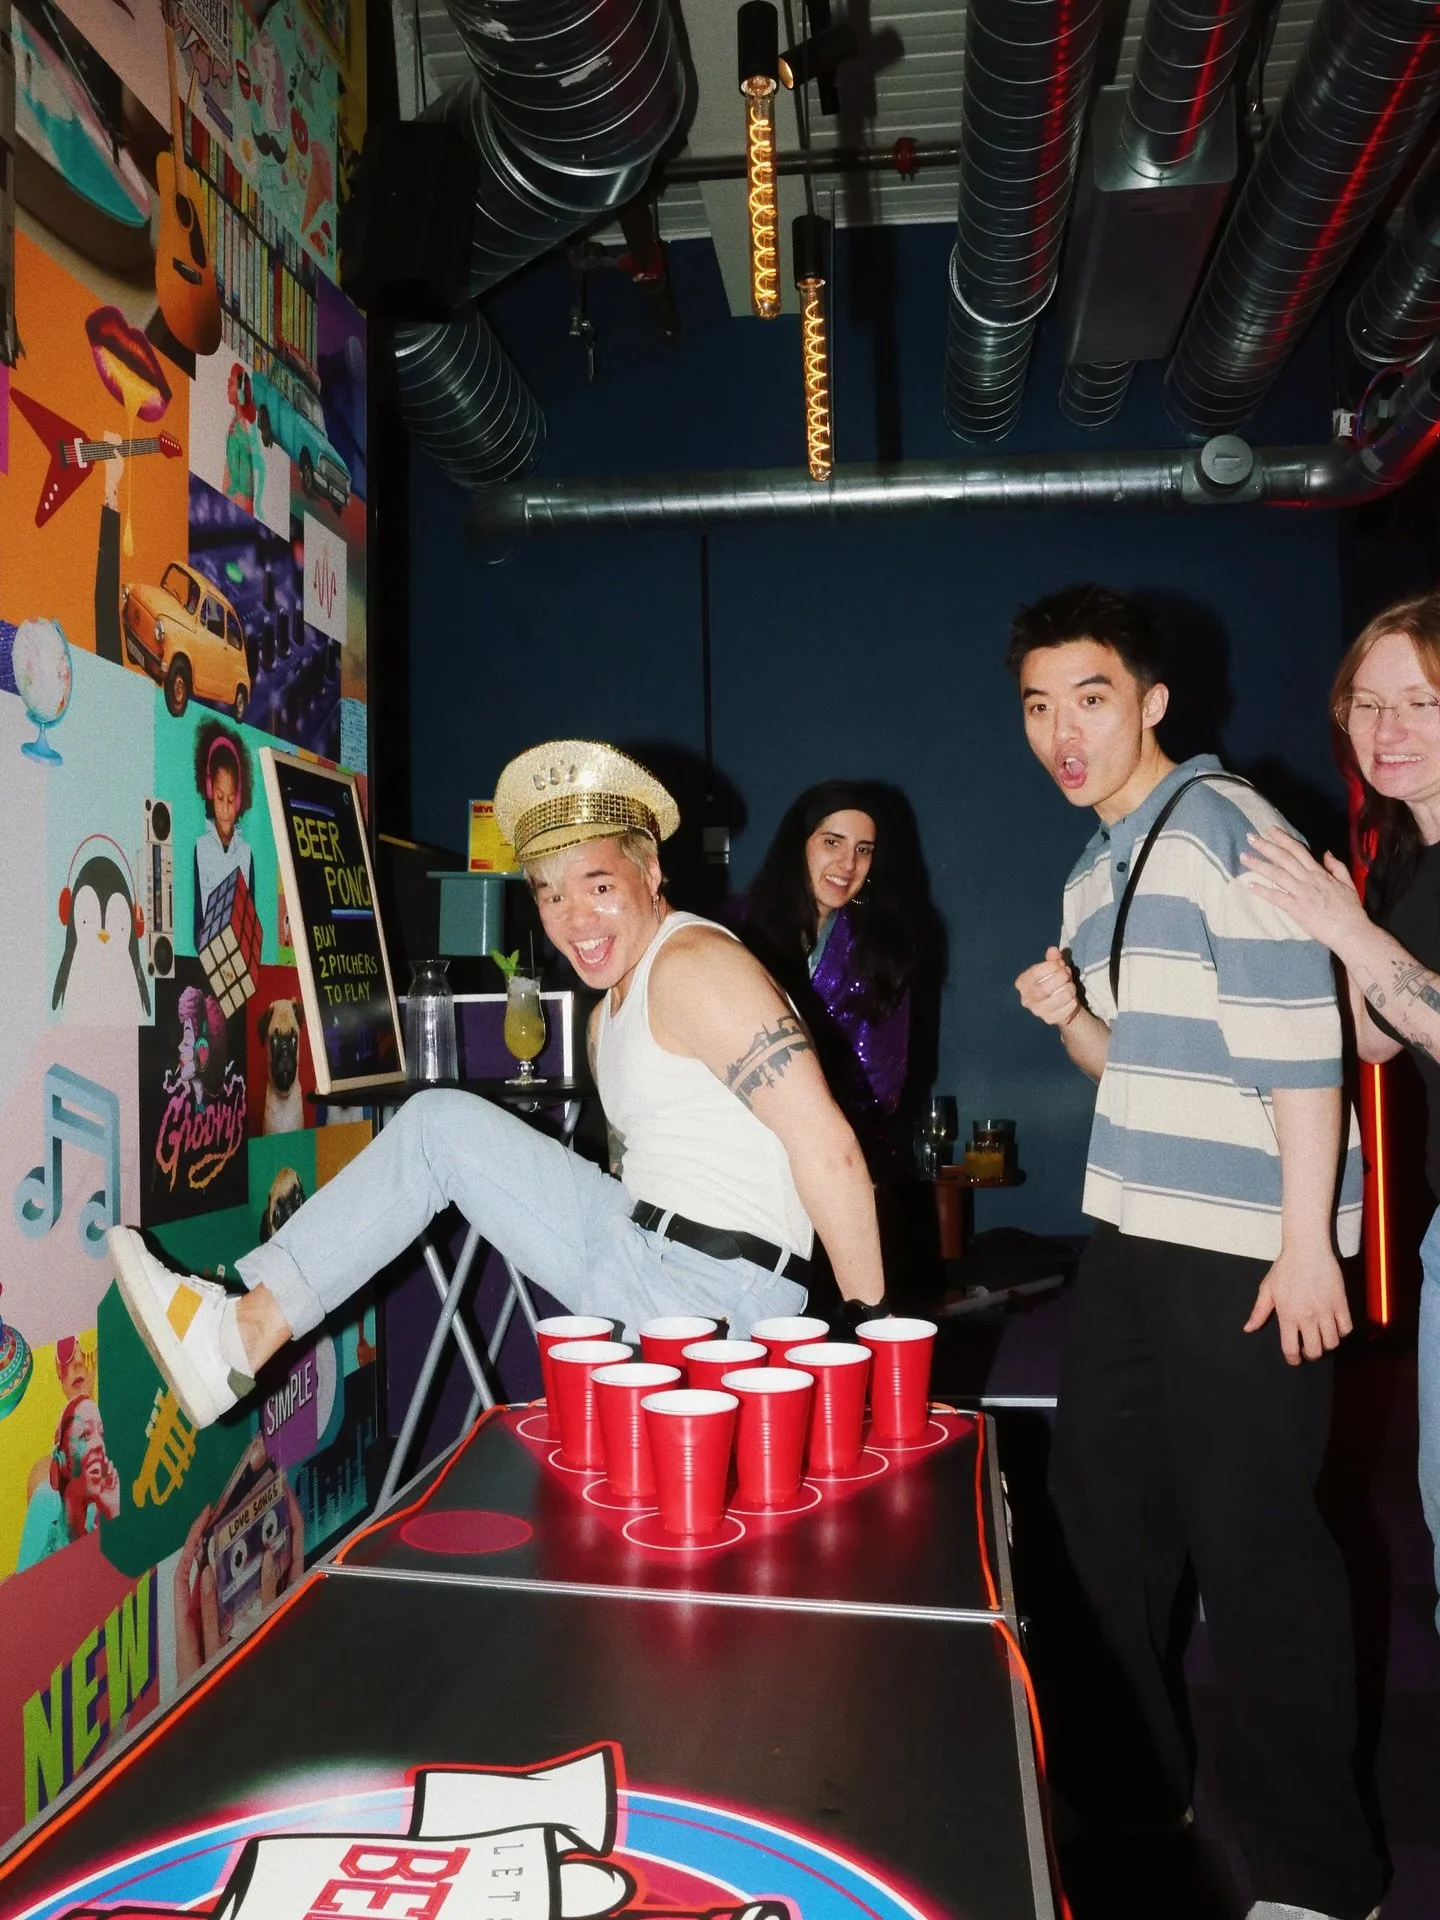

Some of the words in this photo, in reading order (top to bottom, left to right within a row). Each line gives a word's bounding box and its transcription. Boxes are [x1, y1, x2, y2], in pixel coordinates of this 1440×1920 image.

[293, 815, 345, 864] BEER
[324, 865, 372, 908] PONG
[313, 924, 337, 952] BUY
[328, 953, 378, 976] PITCHERS
[324, 985, 342, 1006] TO
[344, 981, 370, 1002] PLAY
[265, 1360, 313, 1437] SIMPLE
[253, 1483, 278, 1516] SONGS
[23, 1568, 153, 1825] NEW
[303, 1844, 471, 1920] BE
